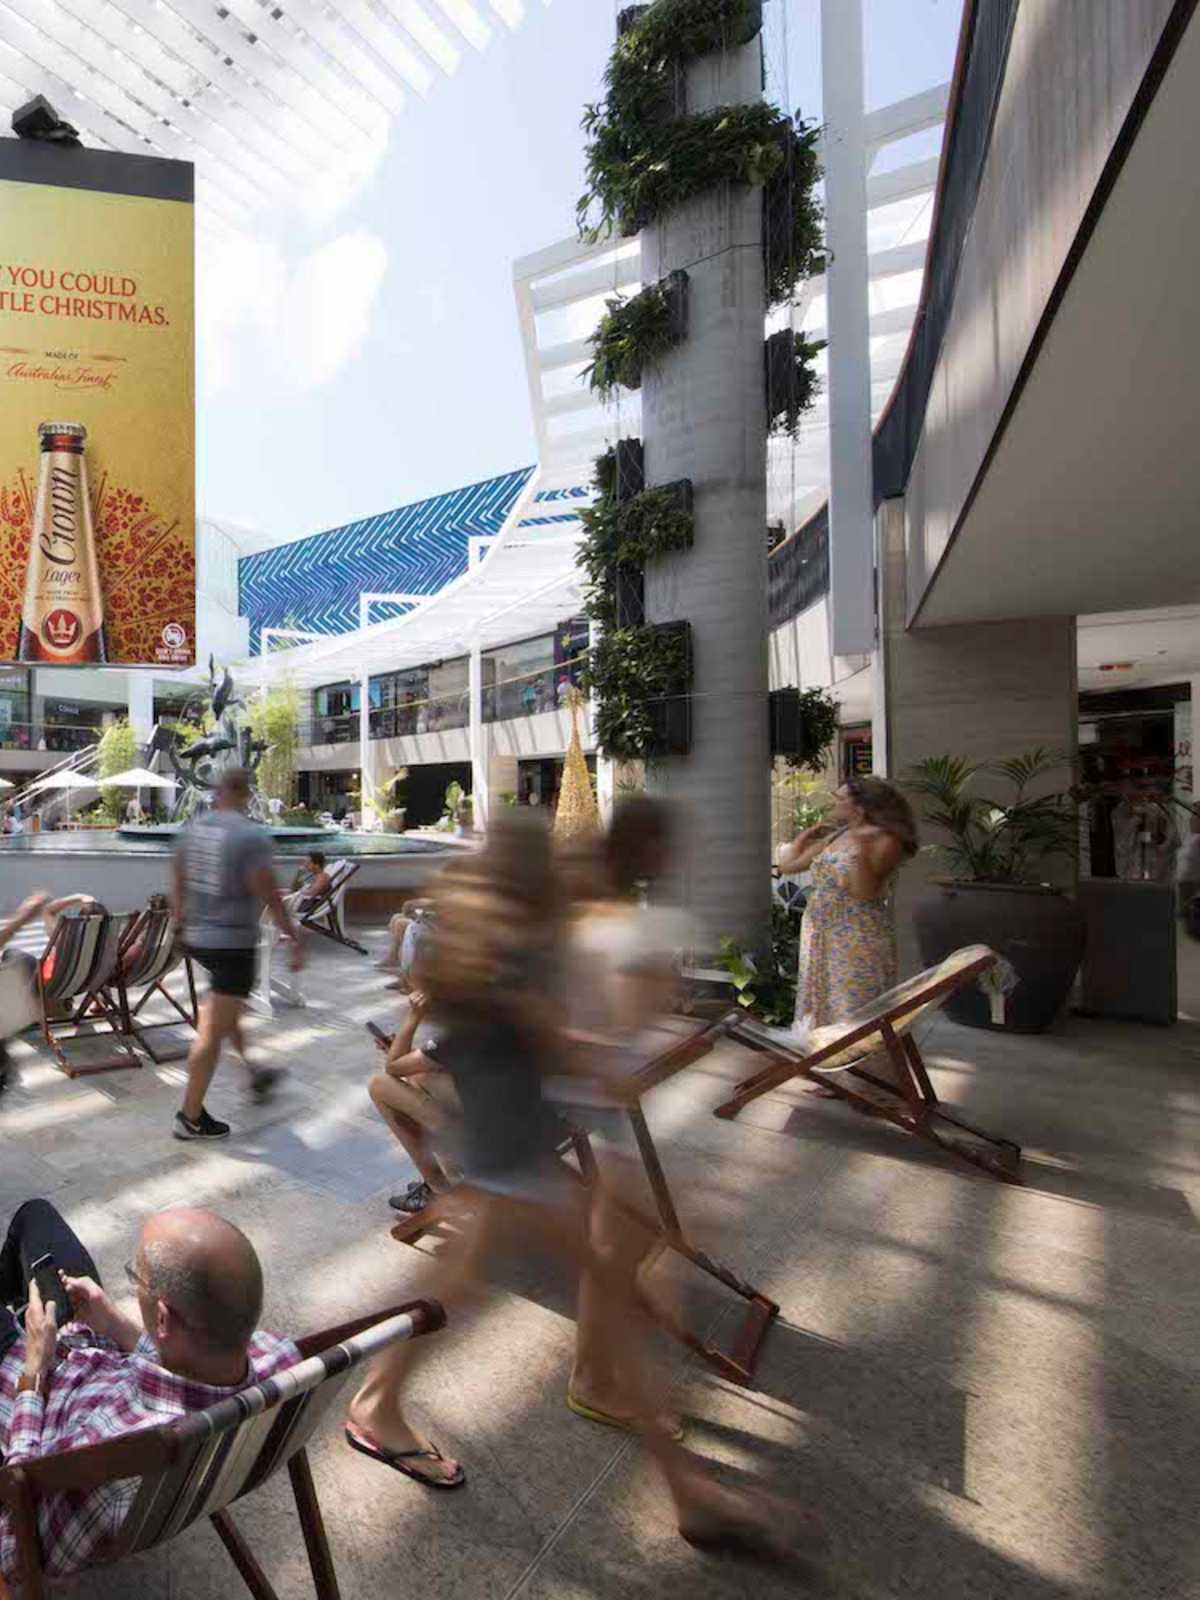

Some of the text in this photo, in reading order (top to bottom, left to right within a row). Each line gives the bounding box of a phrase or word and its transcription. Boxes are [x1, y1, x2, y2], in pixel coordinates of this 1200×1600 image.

[7, 266, 54, 290] YOU
[60, 271, 137, 297] COULD
[39, 296, 170, 326] CHRISTMAS.
[40, 467, 79, 565] Crown
